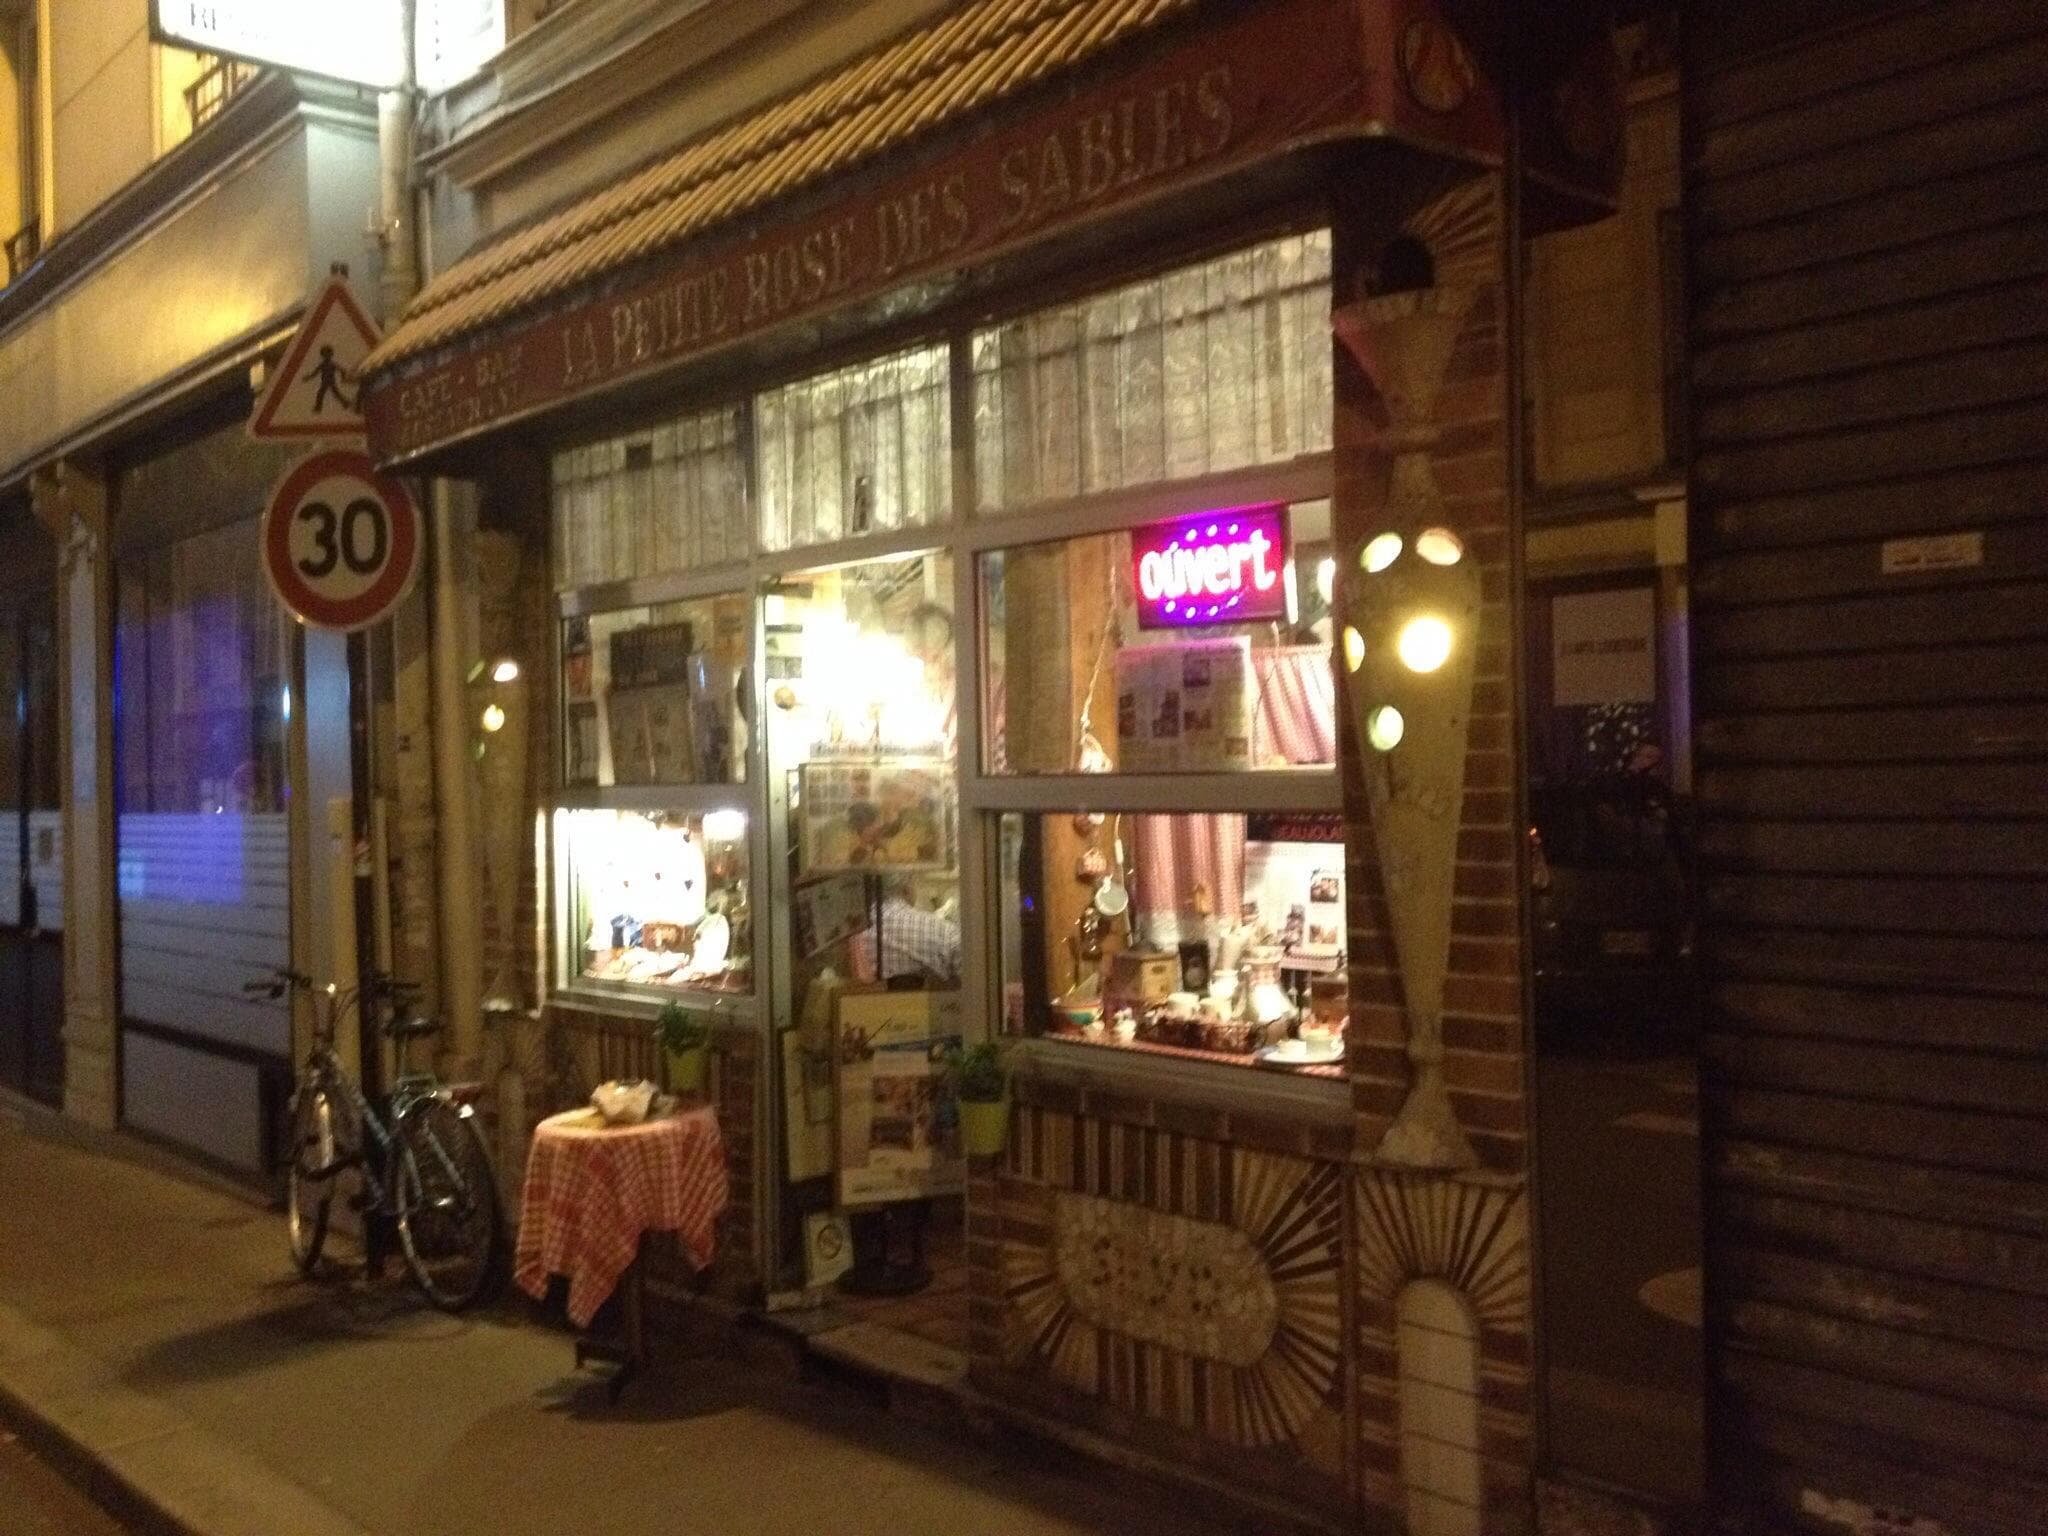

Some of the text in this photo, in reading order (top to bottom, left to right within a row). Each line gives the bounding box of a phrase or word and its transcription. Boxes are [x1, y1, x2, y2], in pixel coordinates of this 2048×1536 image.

[561, 67, 1233, 387] LA PETITE ROSE DES SABLES
[299, 498, 388, 577] 30
[1140, 529, 1276, 600] ouvert
